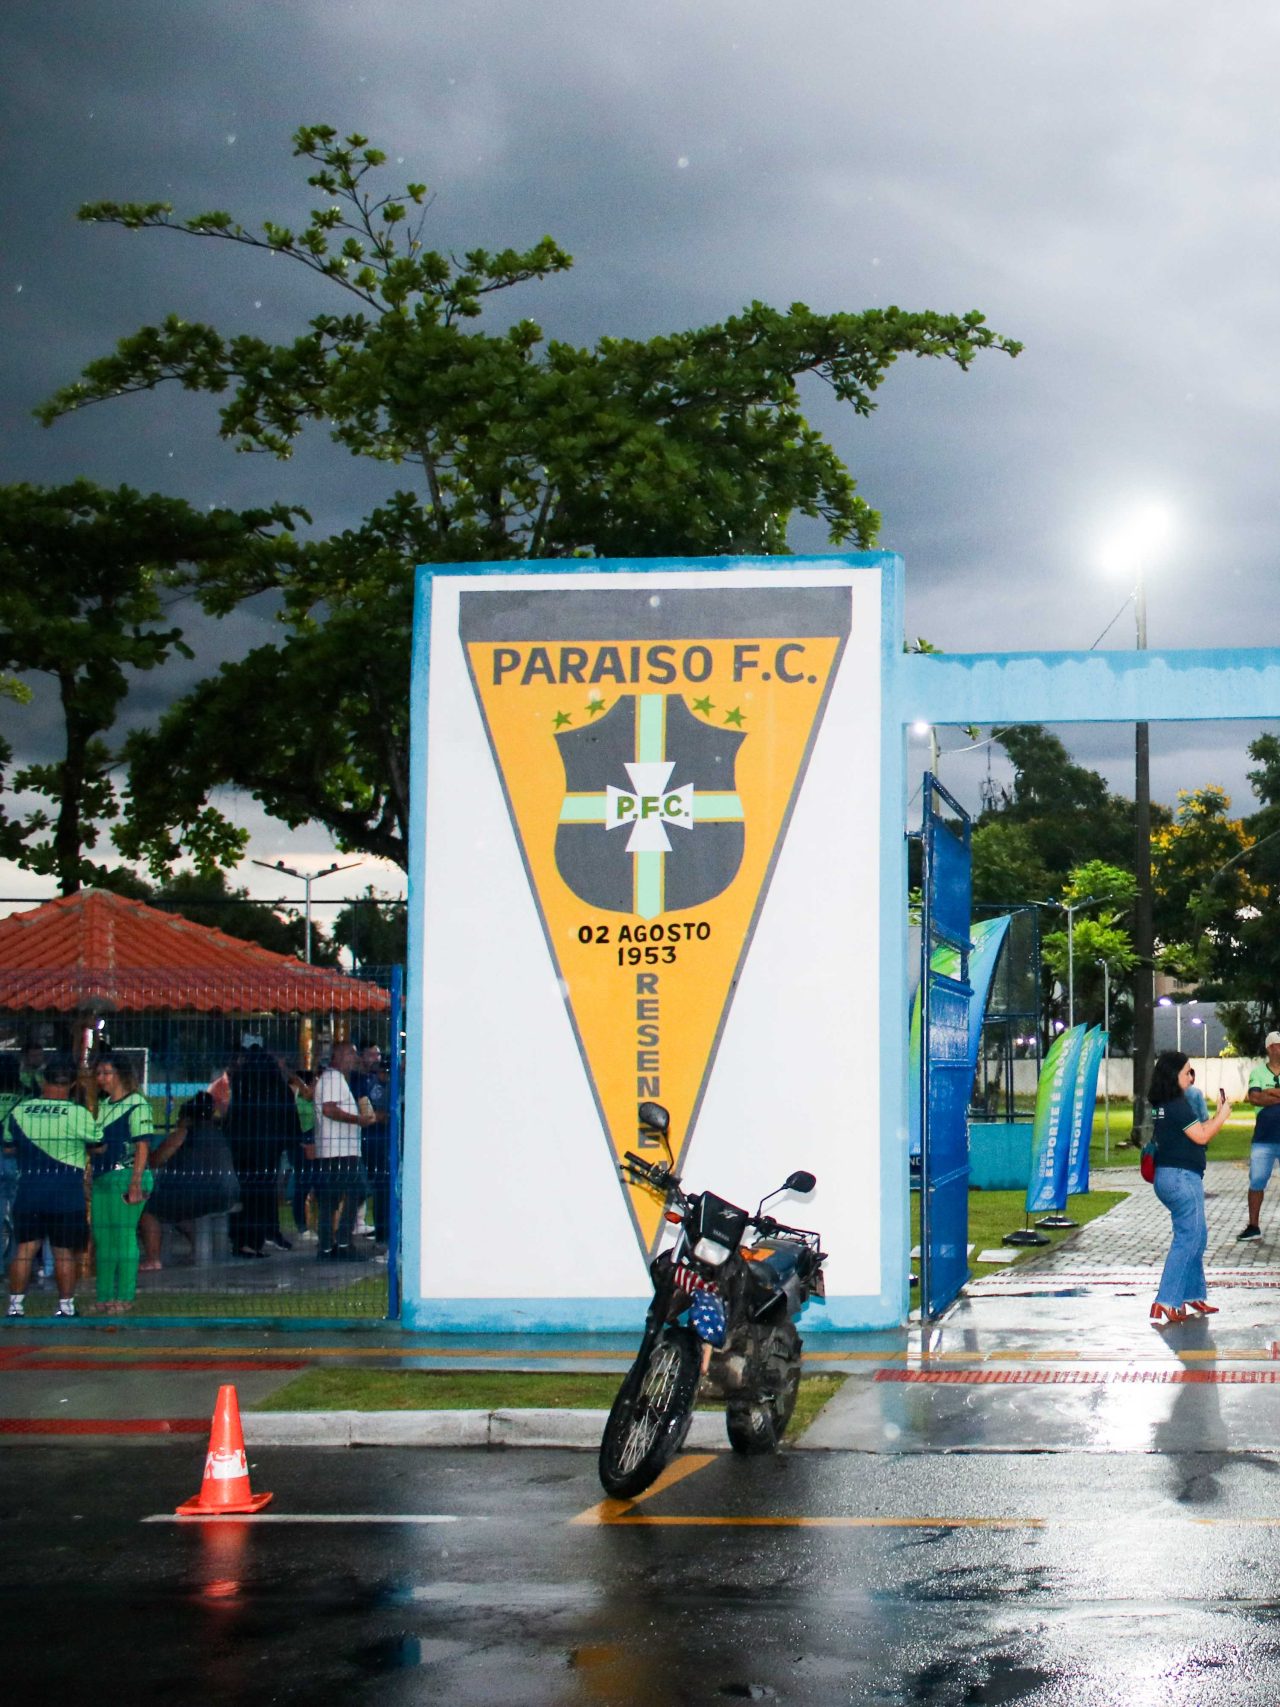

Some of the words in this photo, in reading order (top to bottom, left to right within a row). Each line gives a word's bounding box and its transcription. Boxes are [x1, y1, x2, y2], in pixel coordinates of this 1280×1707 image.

[492, 645, 713, 686] PARAISO
[732, 643, 817, 684] F.C.
[616, 794, 690, 820] P.F.C.
[578, 925, 610, 944] 02
[617, 921, 711, 943] AGOSTO
[617, 946, 677, 966] 1953
[636, 973, 660, 1149] RESENE
[24, 1105, 69, 1116] SEMEL
[1045, 1106, 1060, 1177] ESPORTE
